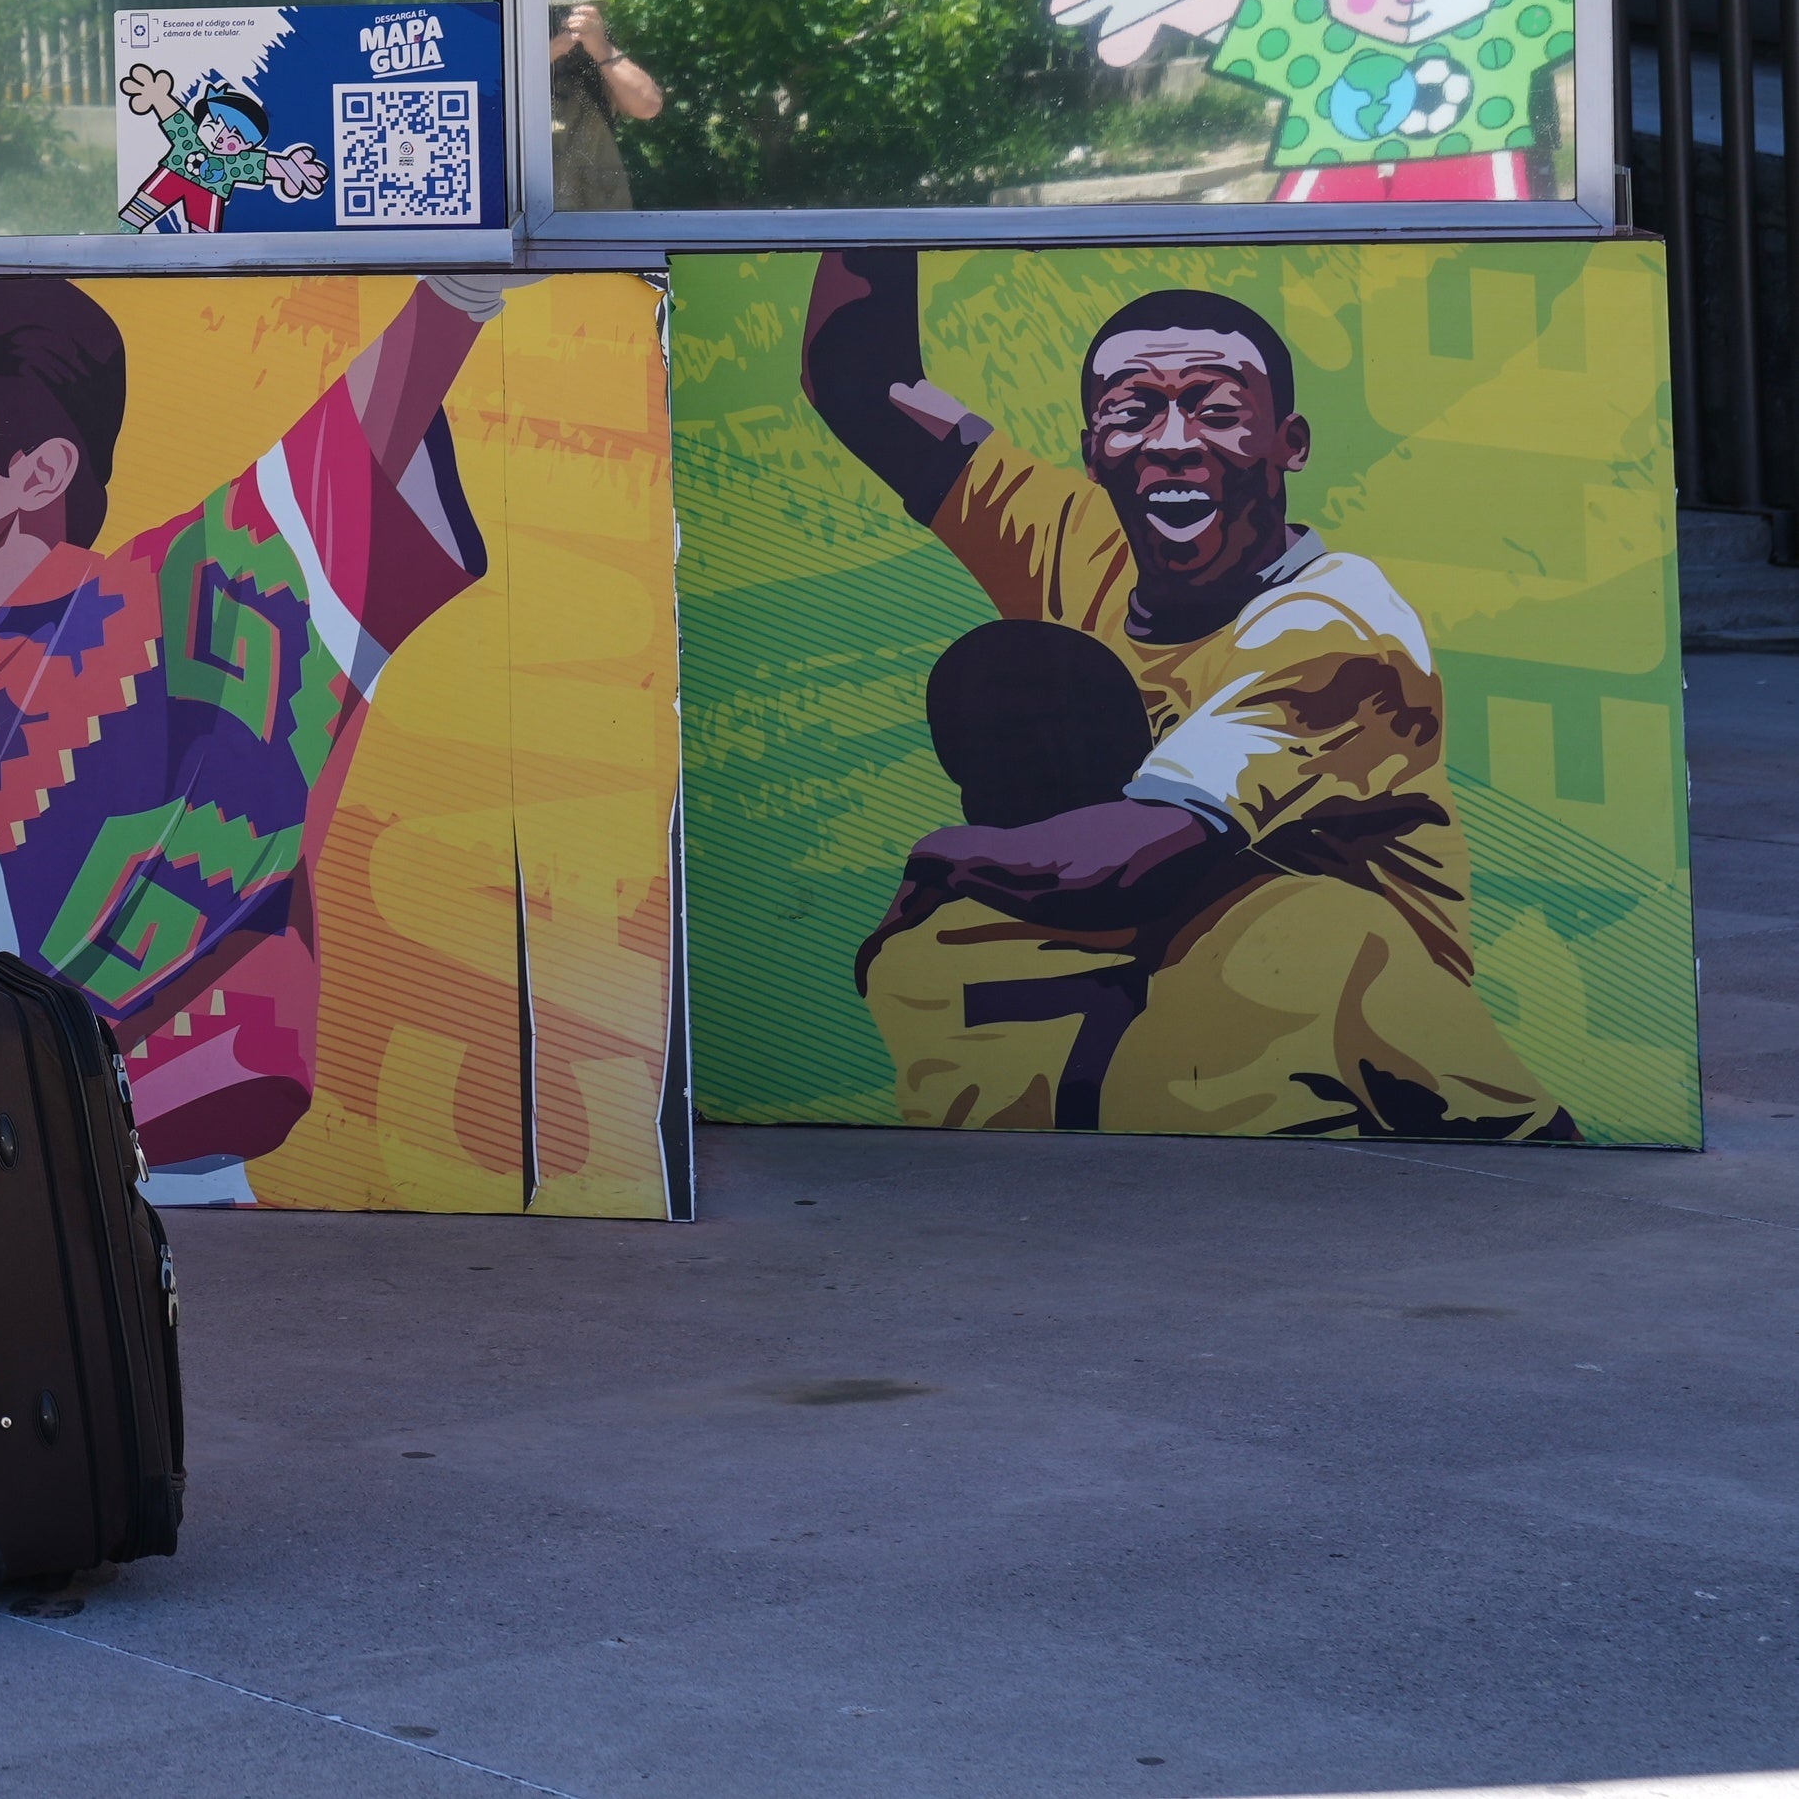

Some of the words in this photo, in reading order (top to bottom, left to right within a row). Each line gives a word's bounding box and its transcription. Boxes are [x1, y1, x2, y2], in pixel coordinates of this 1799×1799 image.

[163, 20, 194, 28] Escanea
[205, 19, 230, 28] código
[375, 11, 417, 24] DESCARGA
[418, 9, 428, 17] EL
[360, 16, 444, 52] MAPA
